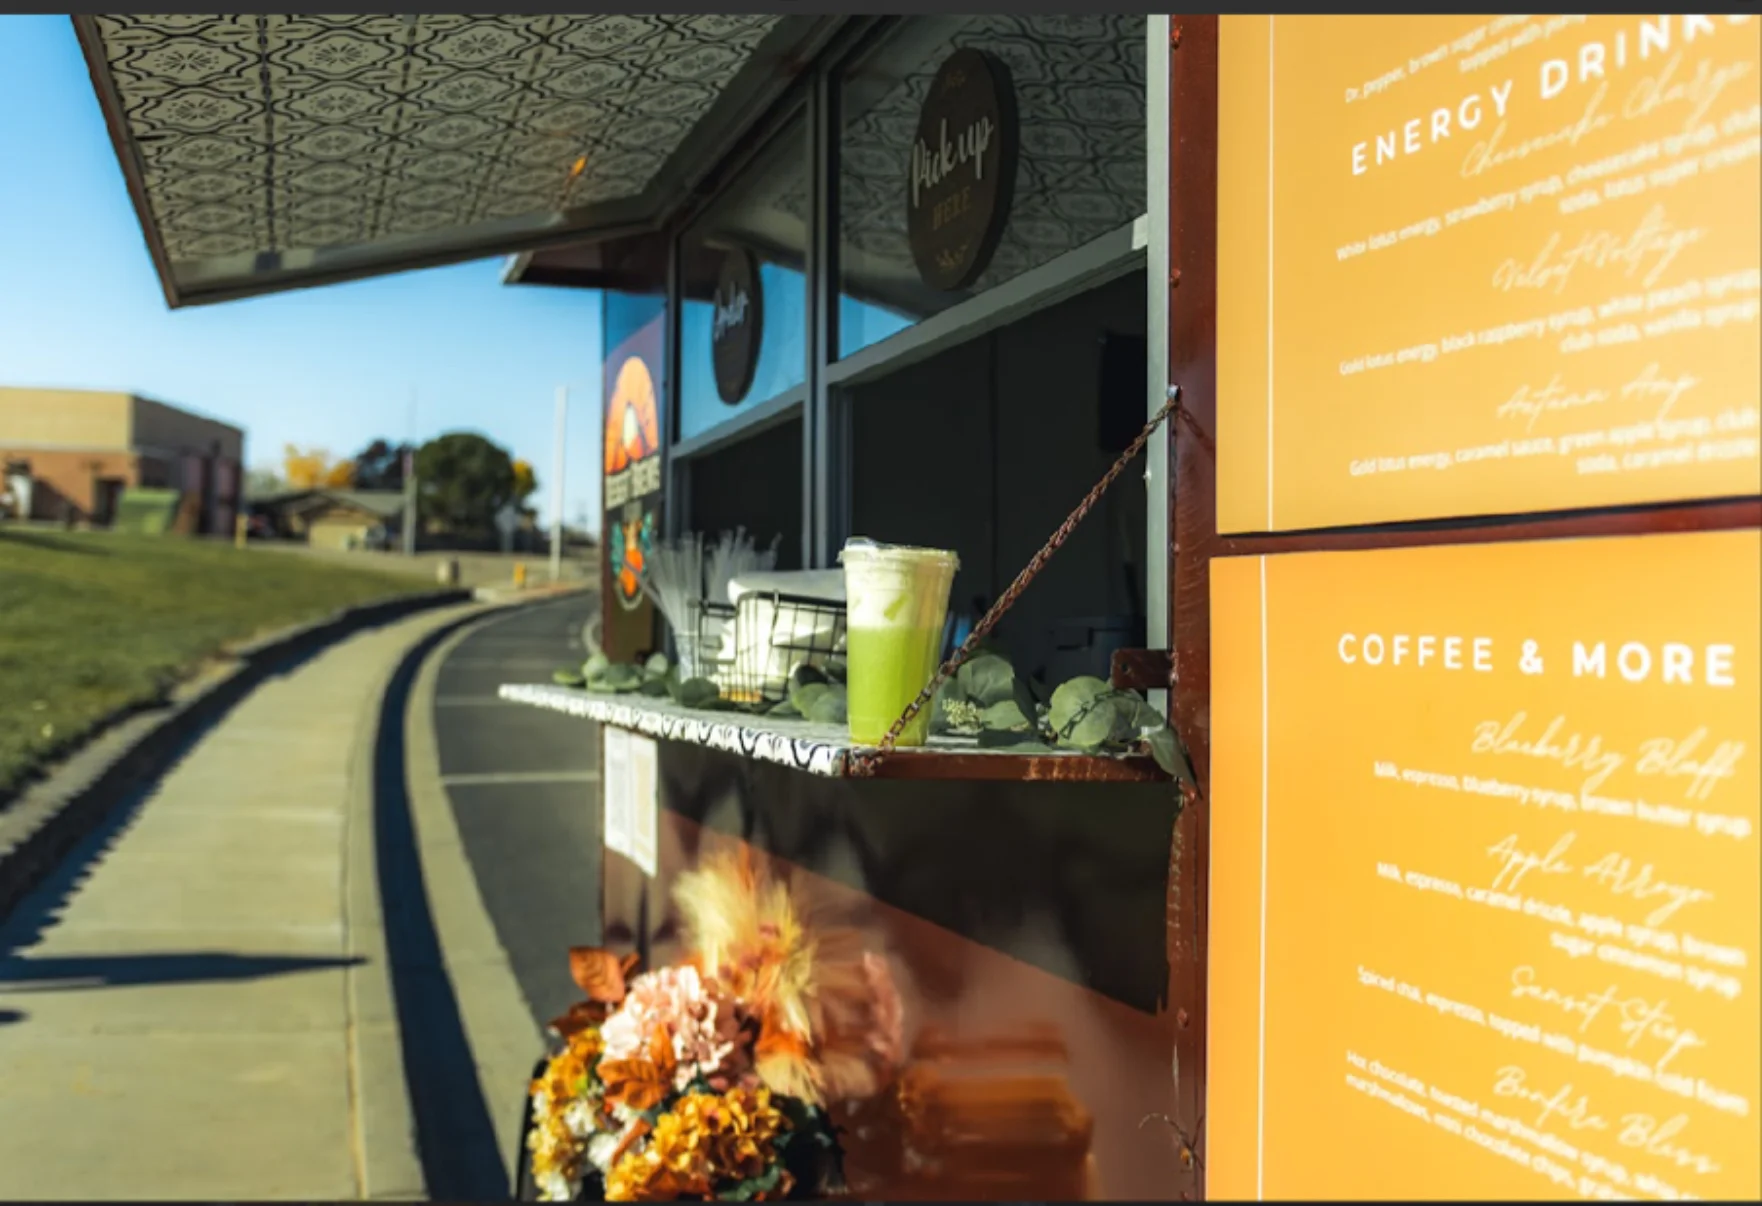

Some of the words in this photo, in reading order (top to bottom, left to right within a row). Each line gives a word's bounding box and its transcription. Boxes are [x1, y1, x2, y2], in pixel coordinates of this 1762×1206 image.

[1351, 79, 1513, 176] ENERGY
[1539, 14, 1752, 100] DRINK
[958, 116, 995, 180] up
[1338, 632, 1494, 672] COFFEE
[1518, 639, 1544, 676] &
[1572, 640, 1736, 687] MORE
[1486, 831, 1578, 891] Apple
